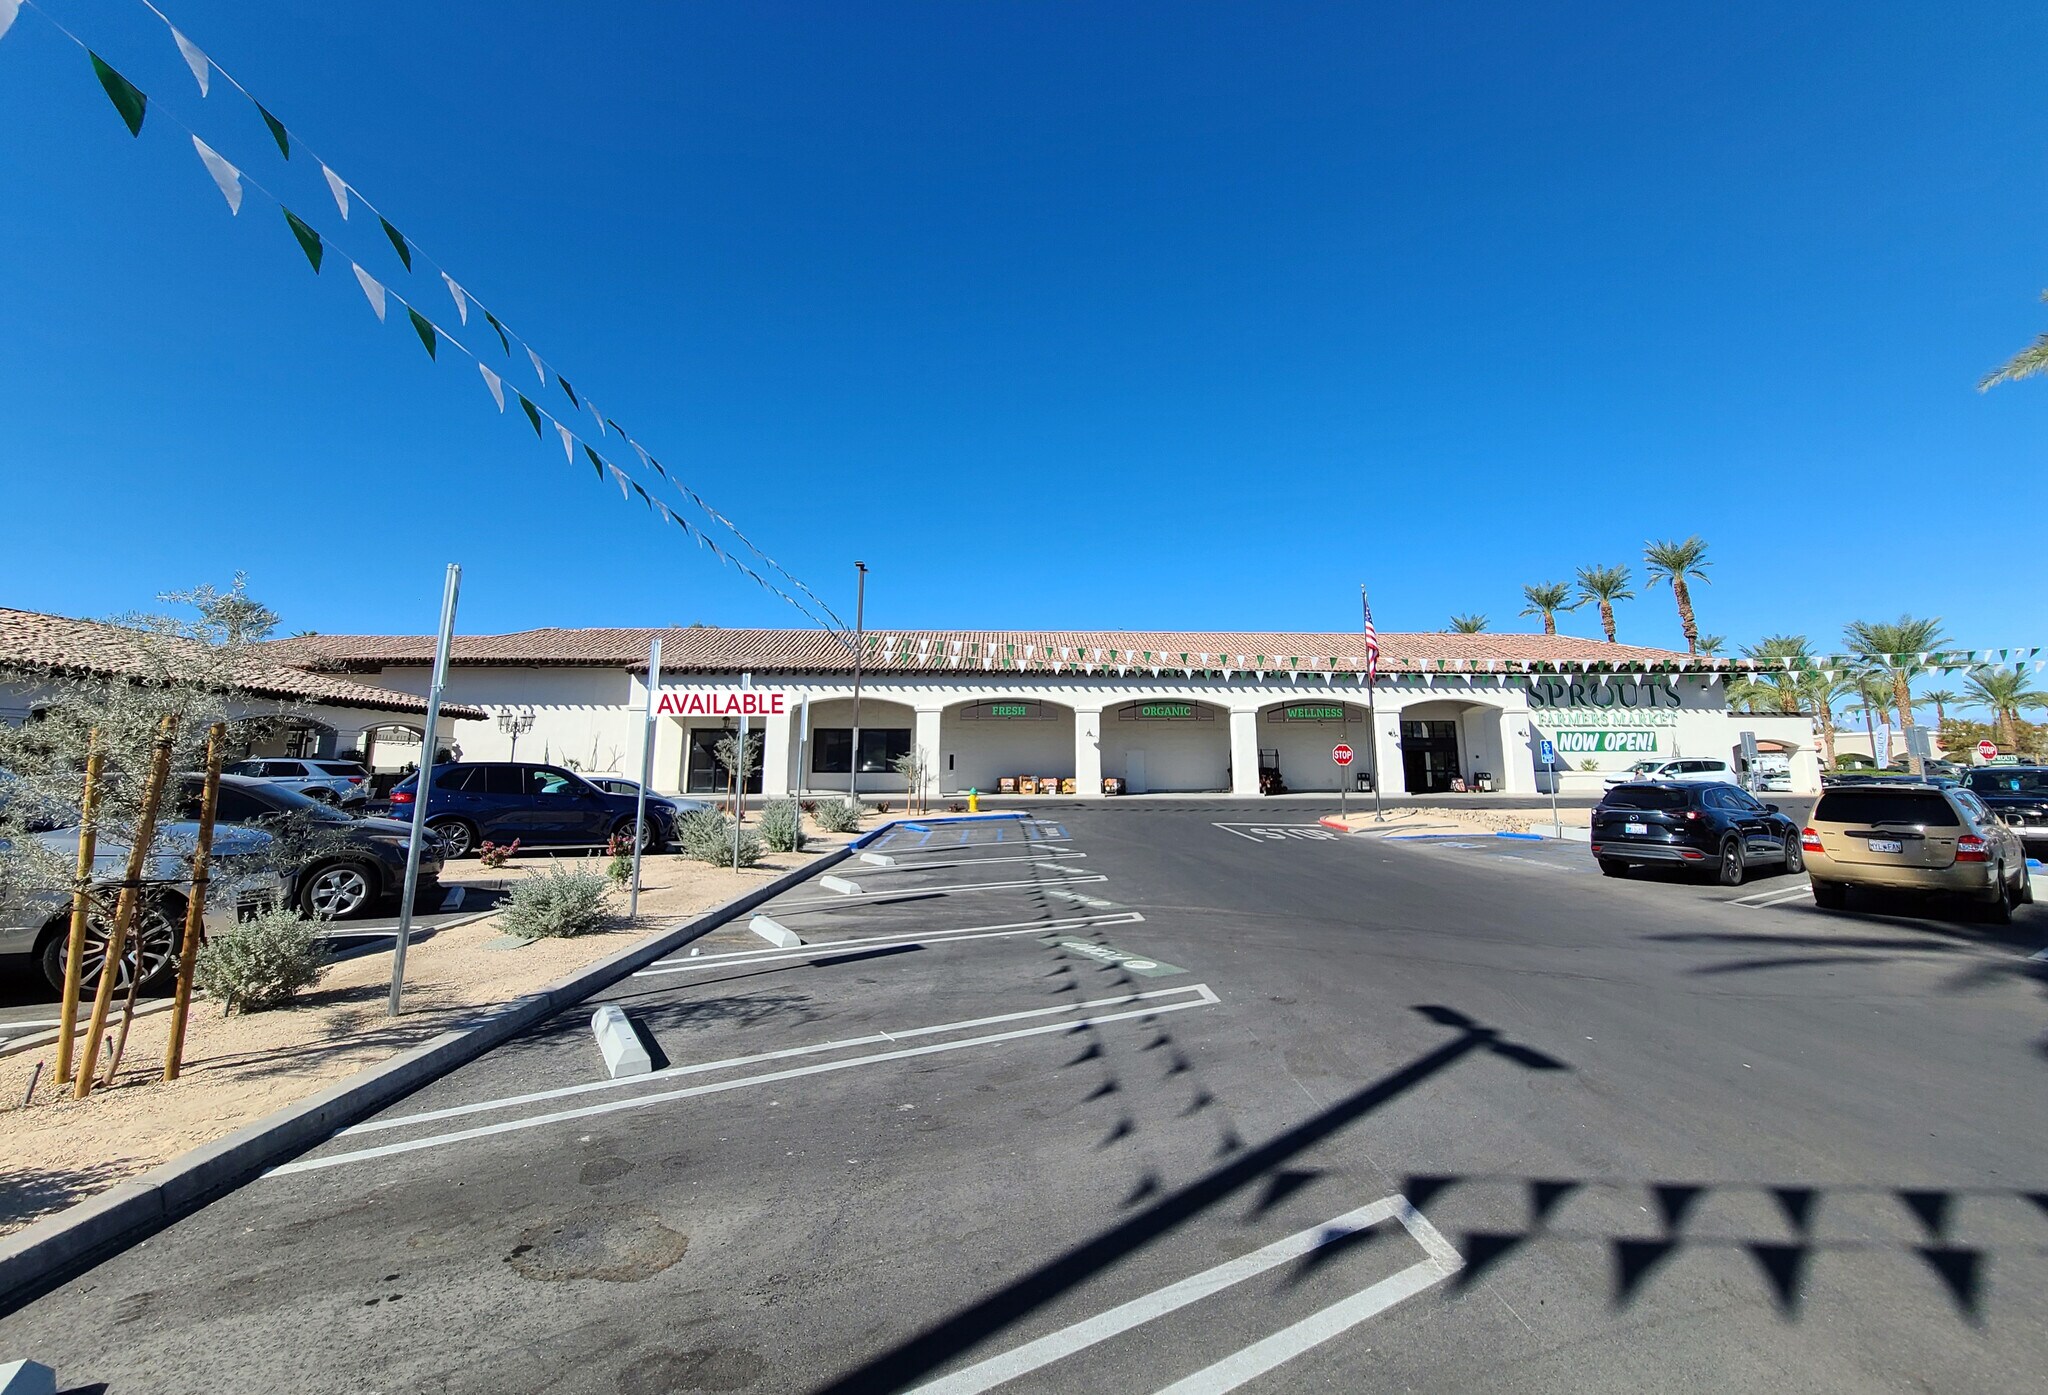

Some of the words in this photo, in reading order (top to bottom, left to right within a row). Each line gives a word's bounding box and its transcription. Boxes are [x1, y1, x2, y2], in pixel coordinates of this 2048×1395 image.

[1527, 682, 1682, 709] SPROUTS
[992, 706, 1026, 716] FRESH
[1142, 706, 1191, 717] ORGANIC
[1287, 708, 1343, 718] WELLNESS
[1537, 712, 1609, 726] FARMERS
[1612, 713, 1679, 726] MARKET
[1559, 732, 1600, 751] NOW
[1604, 732, 1656, 751] OPEN!
[1334, 750, 1352, 759] STOP
[1980, 745, 1996, 755] STOP
[1250, 828, 1340, 841] STOP
